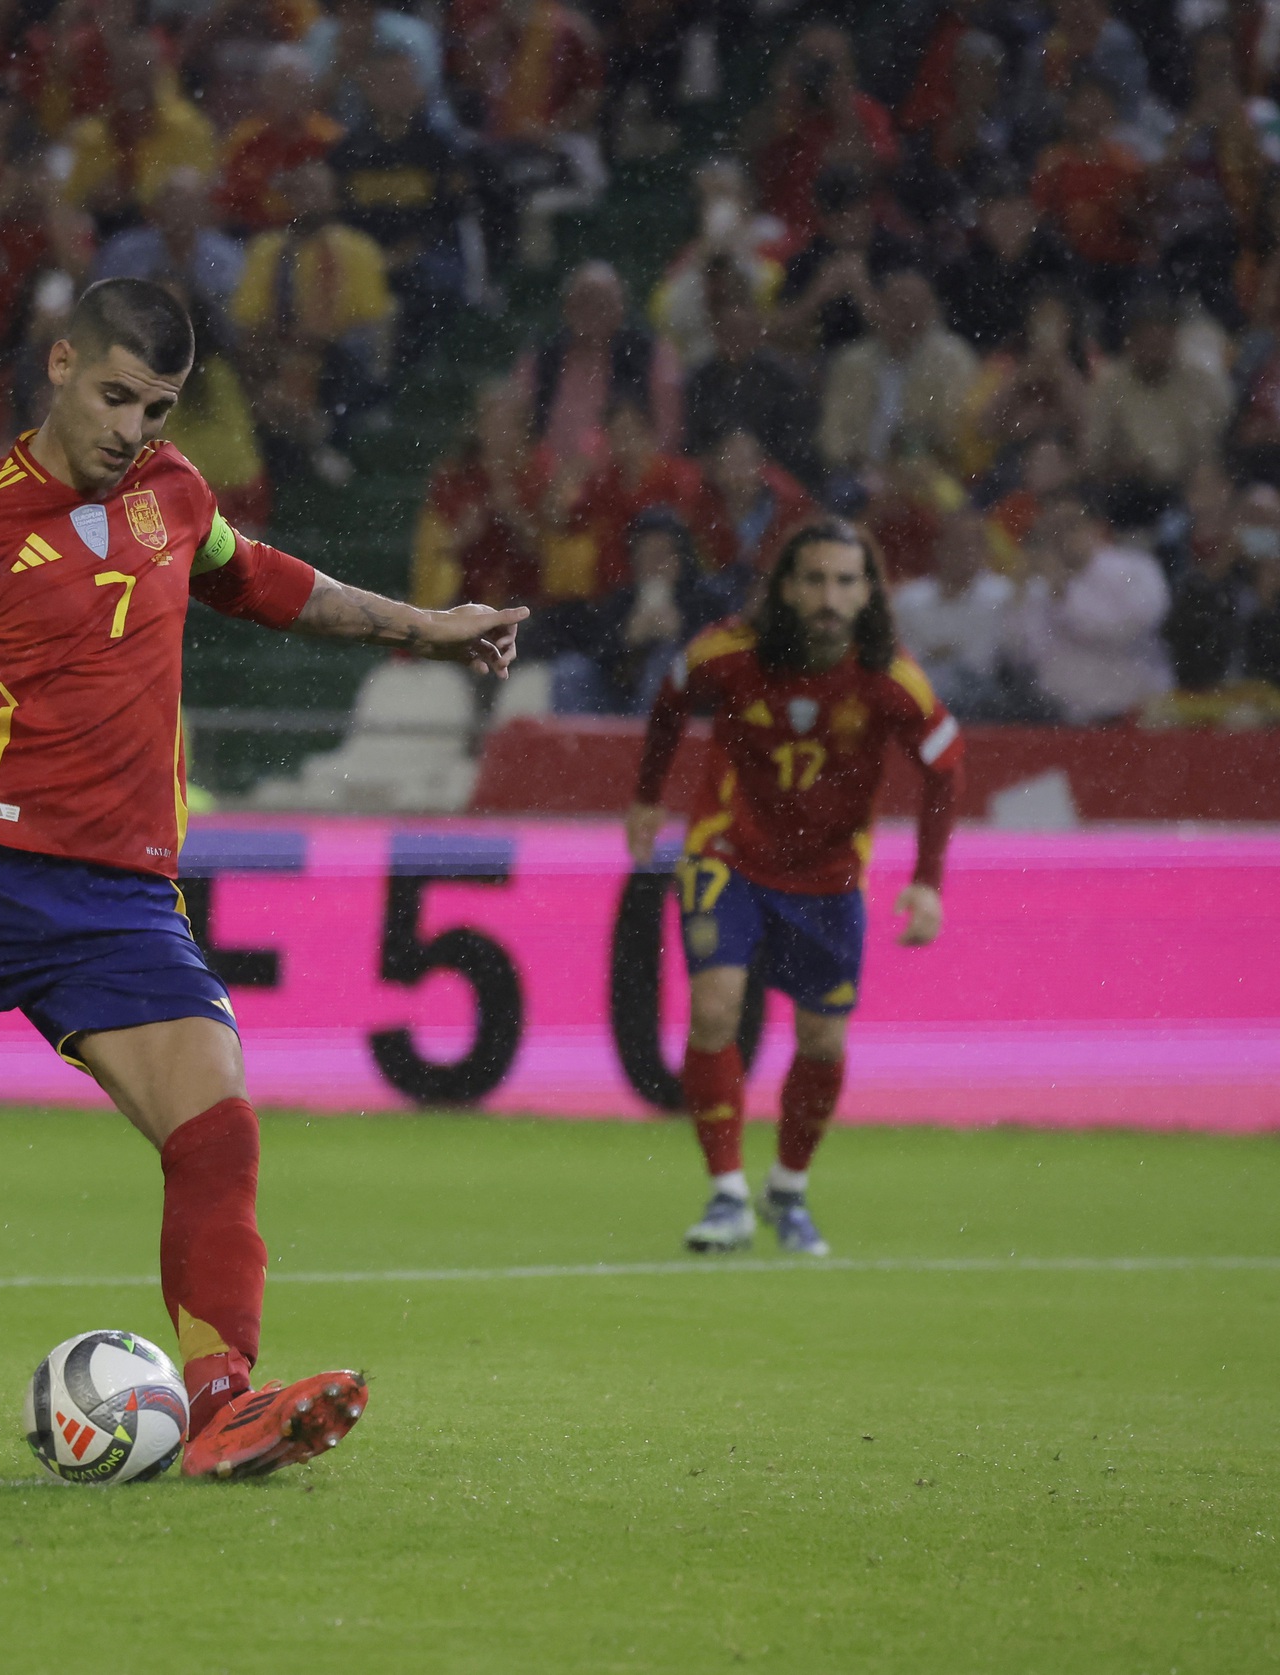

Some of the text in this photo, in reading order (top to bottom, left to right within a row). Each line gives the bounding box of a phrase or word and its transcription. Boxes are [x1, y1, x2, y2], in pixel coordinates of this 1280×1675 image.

[94, 570, 137, 638] 7
[773, 740, 827, 791] 17
[676, 857, 731, 913] 17
[65, 1448, 125, 1480] NATIONS
